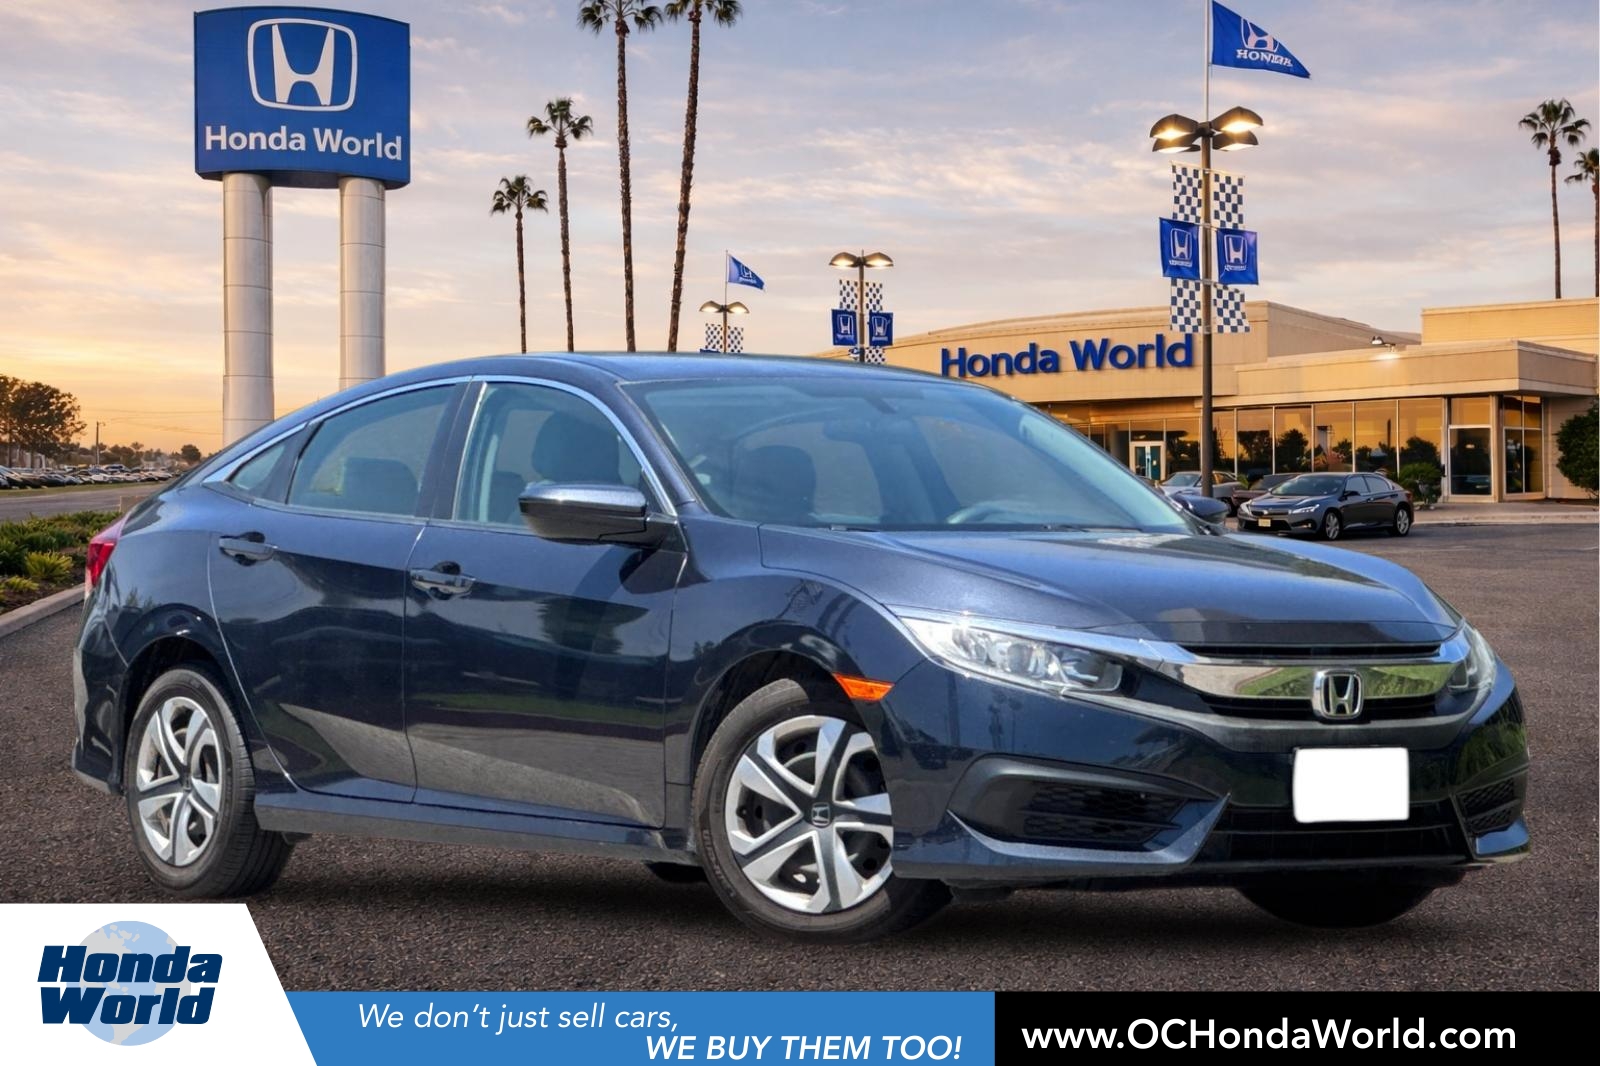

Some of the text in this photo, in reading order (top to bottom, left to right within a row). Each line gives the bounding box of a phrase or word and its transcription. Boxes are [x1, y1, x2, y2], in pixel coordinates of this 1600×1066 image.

[205, 126, 402, 161] Honda World
[941, 333, 1193, 378] Honda World
